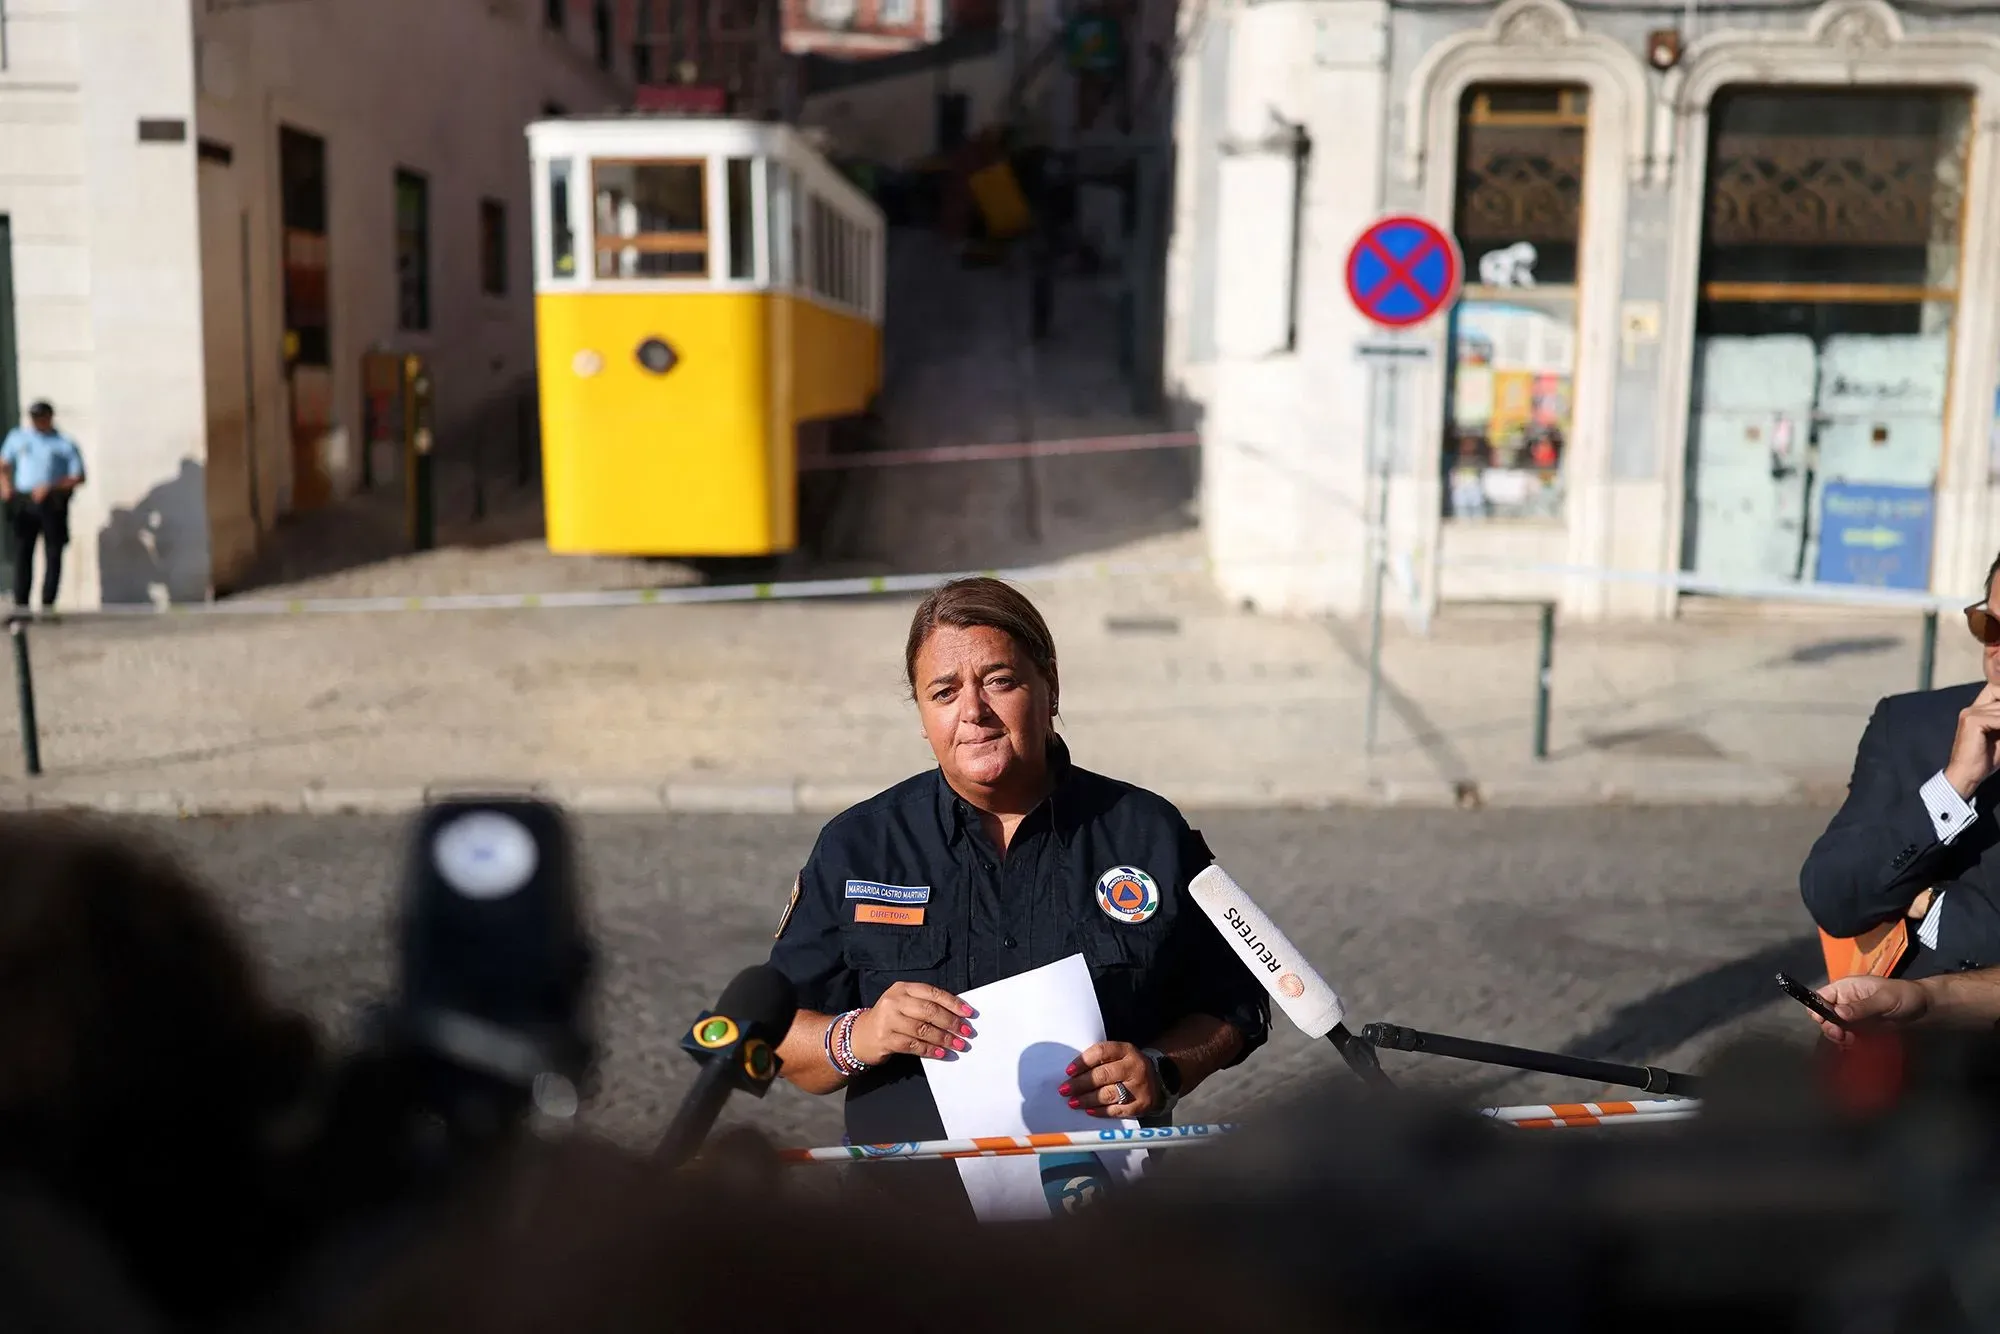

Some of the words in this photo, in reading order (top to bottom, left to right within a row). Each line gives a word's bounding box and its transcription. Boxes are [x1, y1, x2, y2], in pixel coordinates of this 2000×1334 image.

[848, 885, 880, 895] MARGARIDA
[881, 888, 902, 898] CASTRO
[903, 890, 926, 899] MARTINS
[870, 910, 909, 920] DIRETORA
[1223, 907, 1281, 973] REUTERS
